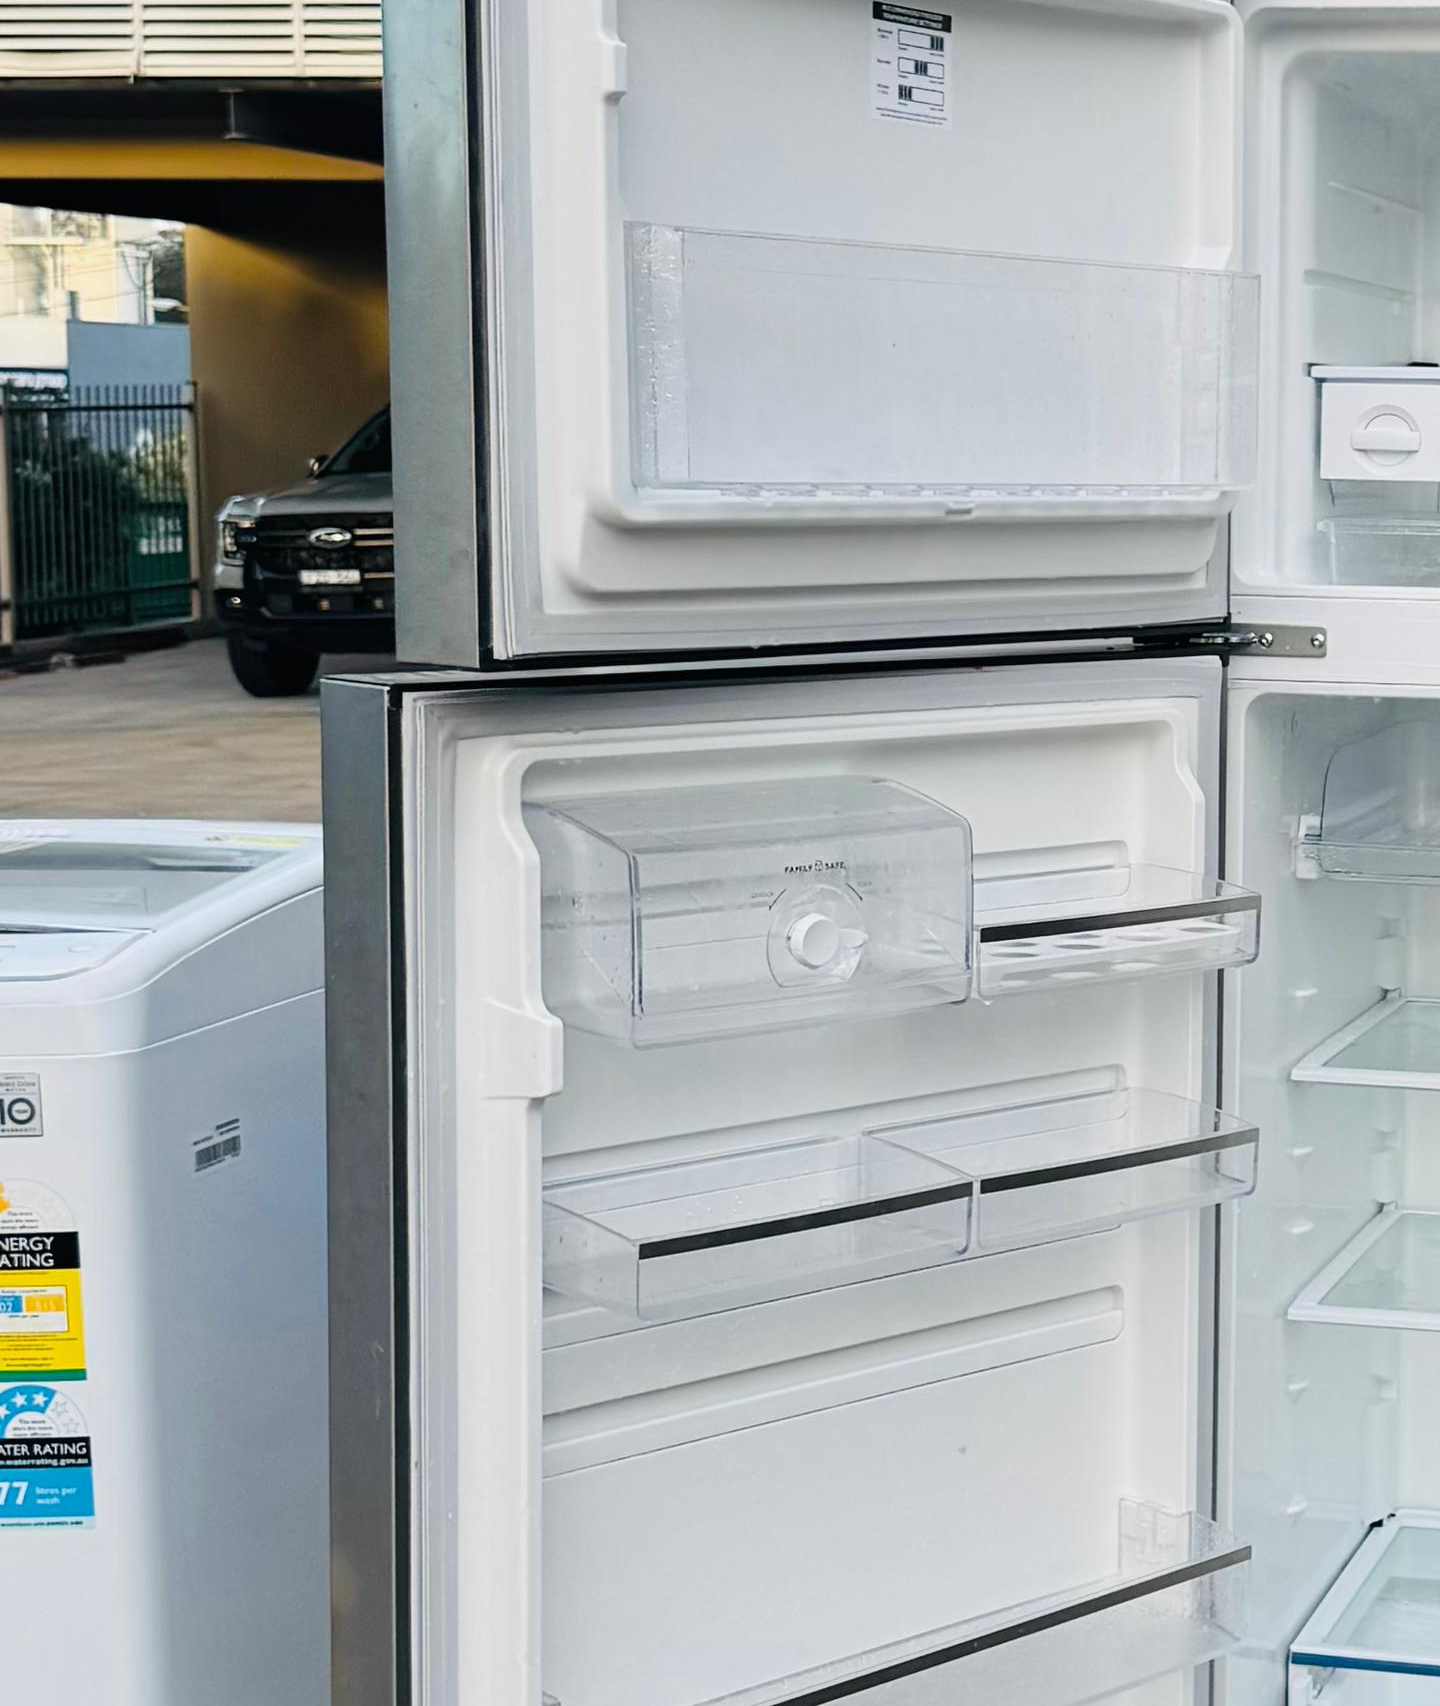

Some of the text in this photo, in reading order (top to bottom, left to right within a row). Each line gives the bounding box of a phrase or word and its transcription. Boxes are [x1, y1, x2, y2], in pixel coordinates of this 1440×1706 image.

[0, 1236, 55, 1252] NERGY
[0, 1252, 55, 1268] ATING
[0, 1441, 88, 1457] ATER RATING
[0, 1480, 30, 1506] 77
